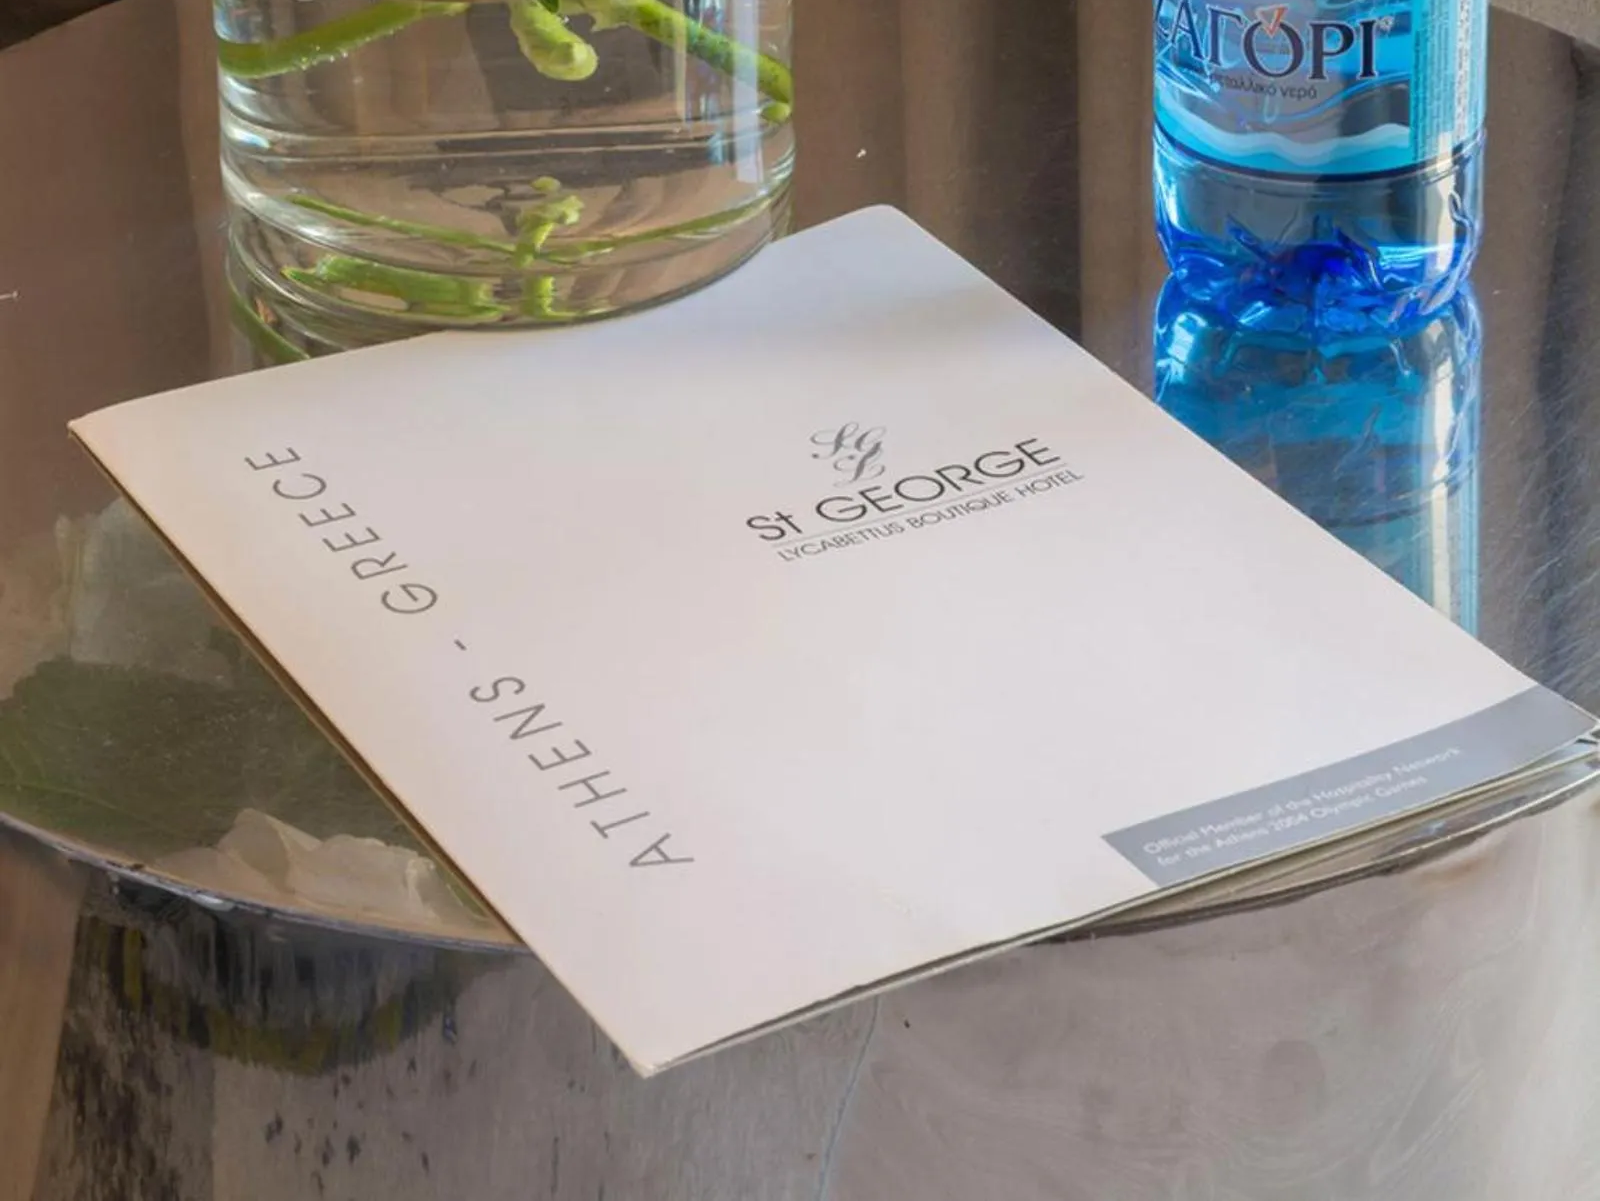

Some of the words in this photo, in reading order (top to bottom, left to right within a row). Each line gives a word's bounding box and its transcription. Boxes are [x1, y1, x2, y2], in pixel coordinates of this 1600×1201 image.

[244, 446, 439, 614] GREECE
[746, 510, 803, 541] St
[815, 438, 1061, 522] GEORGE
[776, 521, 906, 562] LYCABETTUS
[906, 489, 1016, 529] BOUTIQUE
[1014, 469, 1085, 499] HOTEL
[468, 675, 696, 868] ATHENS
